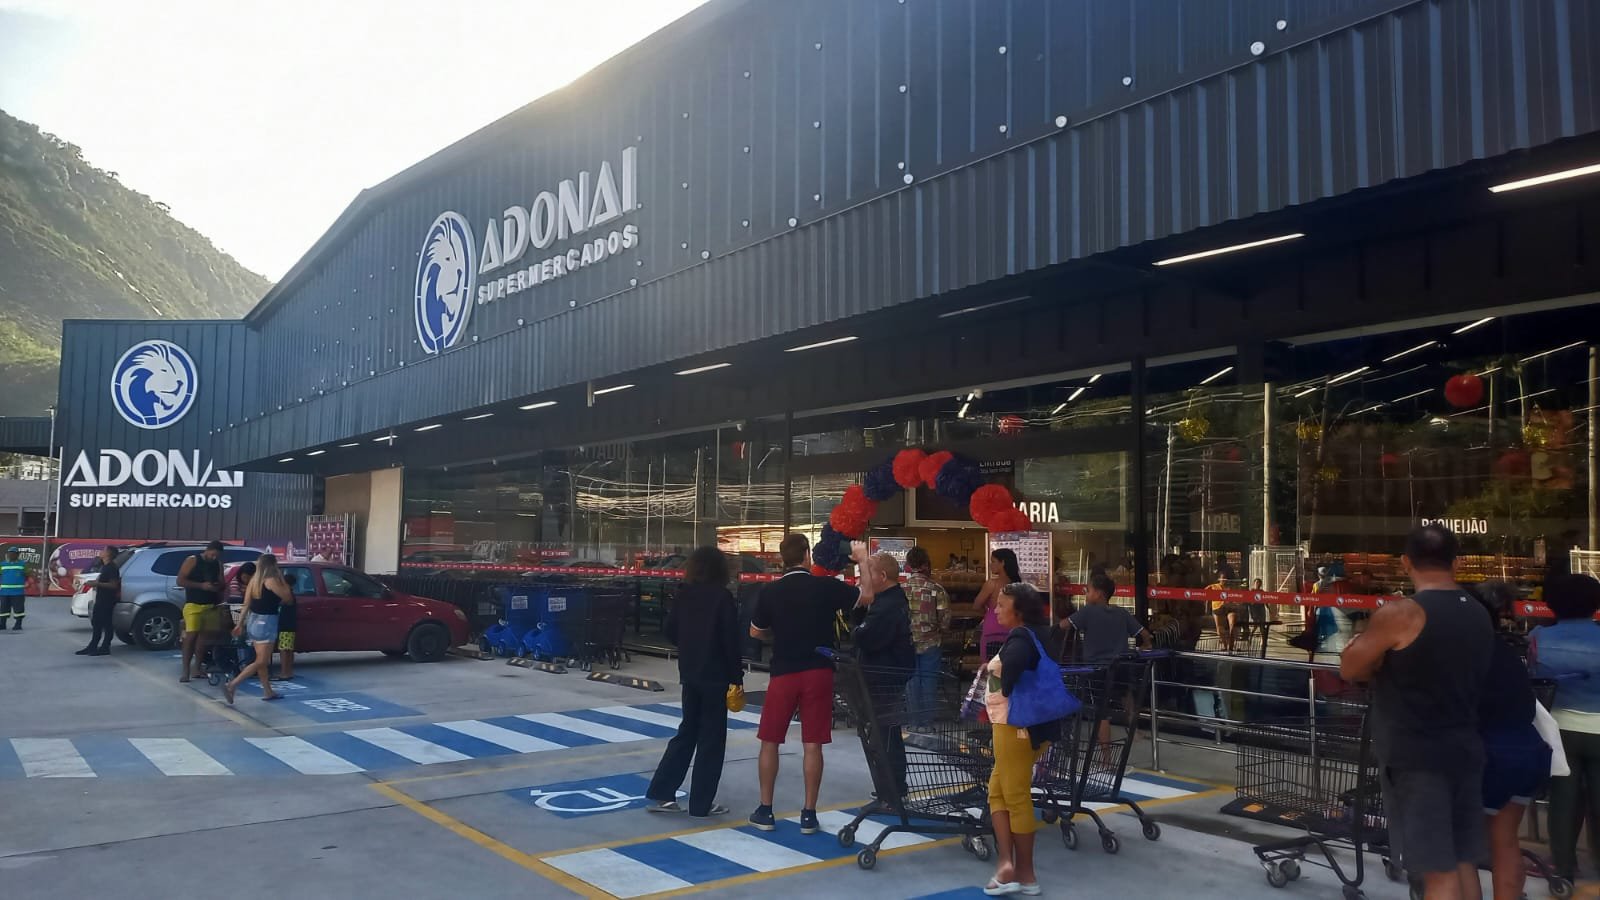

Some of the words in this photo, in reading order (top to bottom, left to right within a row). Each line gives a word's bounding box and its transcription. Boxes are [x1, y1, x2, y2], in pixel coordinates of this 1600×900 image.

[478, 146, 638, 275] ADONAI
[478, 224, 639, 305] SUPERMERCADOS
[69, 493, 232, 508] SUPERMERCADOS
[1013, 501, 1060, 523] ARIA
